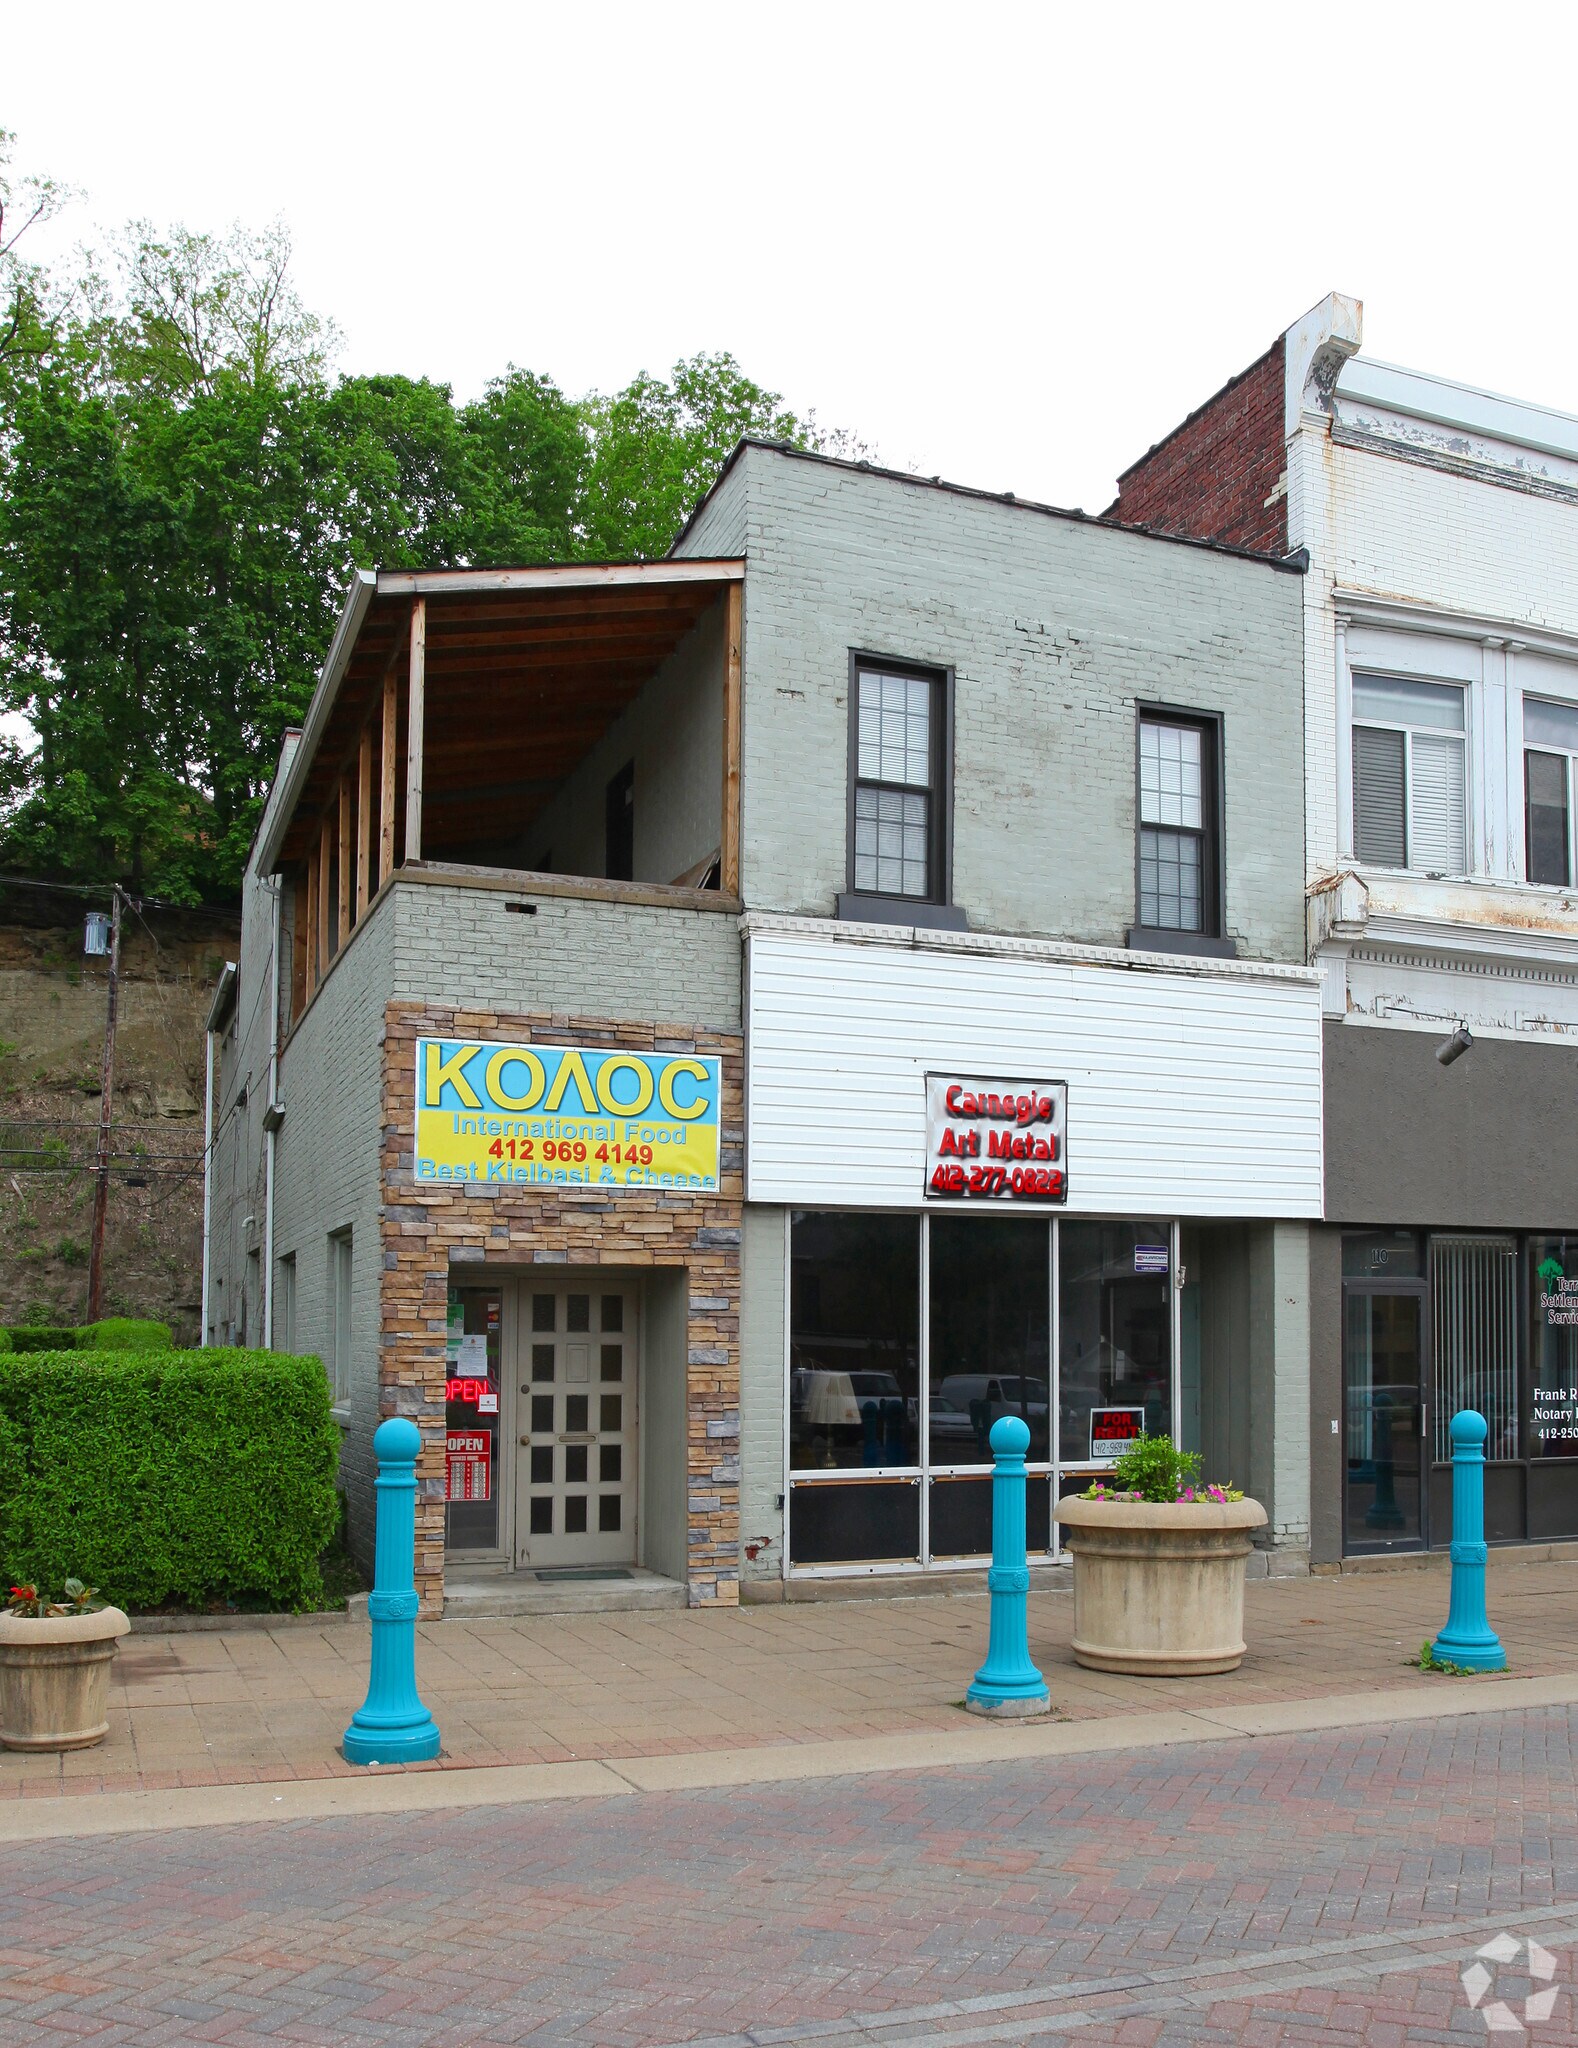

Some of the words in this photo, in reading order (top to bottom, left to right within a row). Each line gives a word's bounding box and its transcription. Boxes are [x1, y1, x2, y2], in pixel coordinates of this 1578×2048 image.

[945, 1084, 1051, 1125] Carnegie
[453, 1113, 616, 1142] International
[625, 1122, 688, 1145] Food
[488, 1138, 535, 1160] 412
[542, 1140, 587, 1163] 969
[595, 1143, 654, 1165] 4149
[938, 1127, 978, 1157] Art
[988, 1129, 1056, 1160] Metal
[418, 1158, 478, 1180] Best
[487, 1161, 591, 1184] Kielbasi
[598, 1165, 617, 1185] &
[625, 1166, 717, 1189] Cheese
[931, 1163, 1062, 1195] 412-277-0822
[1533, 1387, 1567, 1401] Frank
[1103, 1413, 1131, 1426] FOR
[1533, 1407, 1573, 1422] Notary
[447, 1437, 484, 1451] OPEN
[1095, 1426, 1138, 1440] RENT
